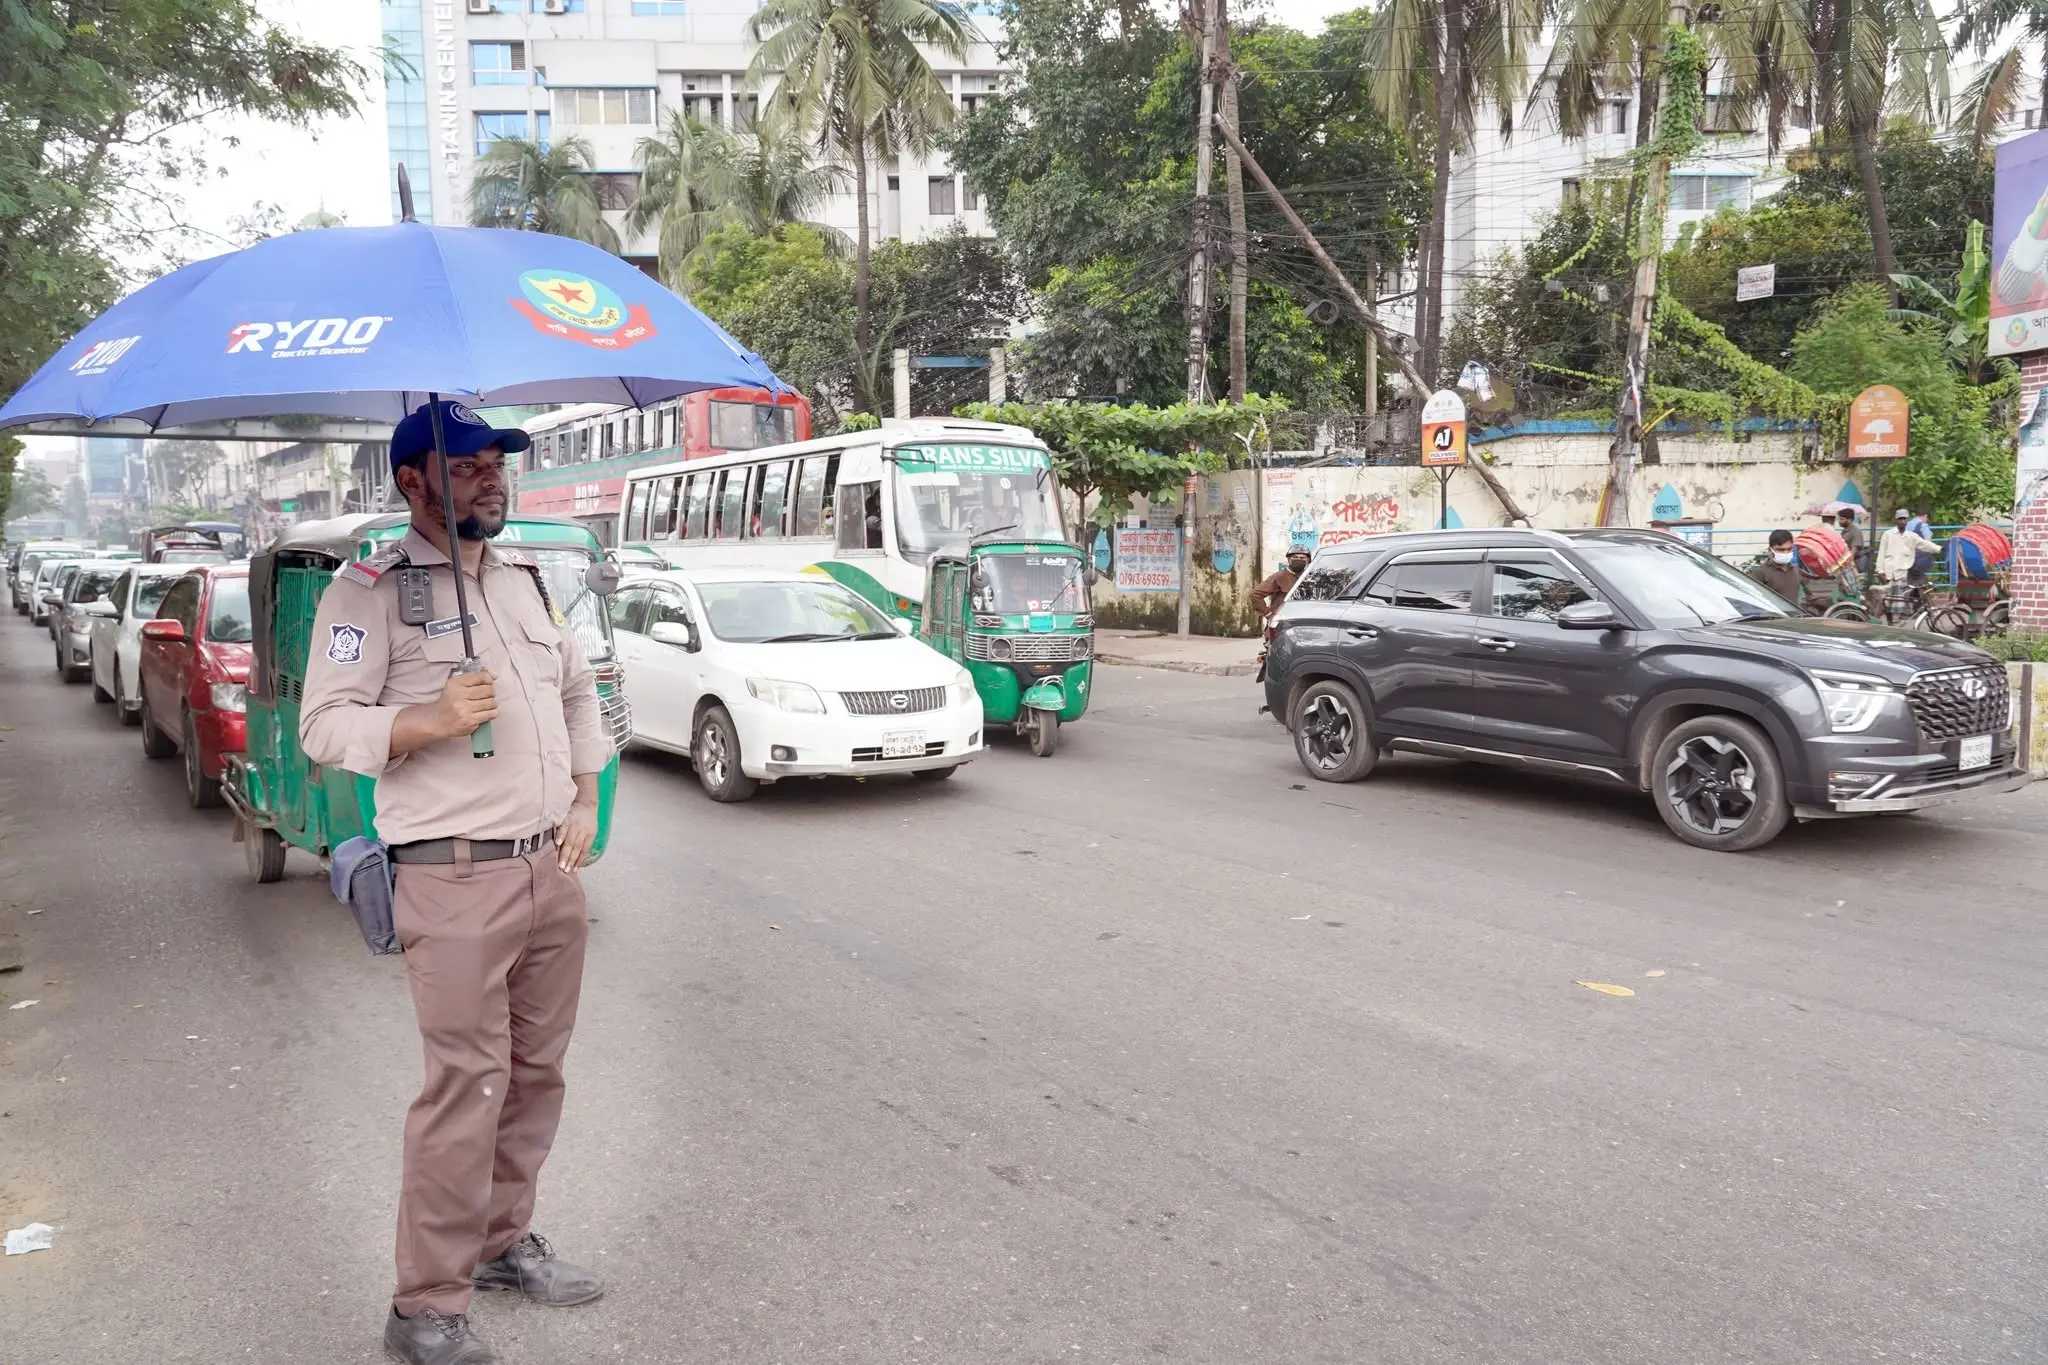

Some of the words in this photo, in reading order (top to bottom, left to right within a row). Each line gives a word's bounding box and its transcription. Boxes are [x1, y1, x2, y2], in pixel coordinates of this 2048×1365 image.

[439, 89, 460, 158] TANIN
[225, 316, 384, 353] RYDO
[910, 446, 985, 465] TRANS
[988, 449, 1048, 469] SILVA
